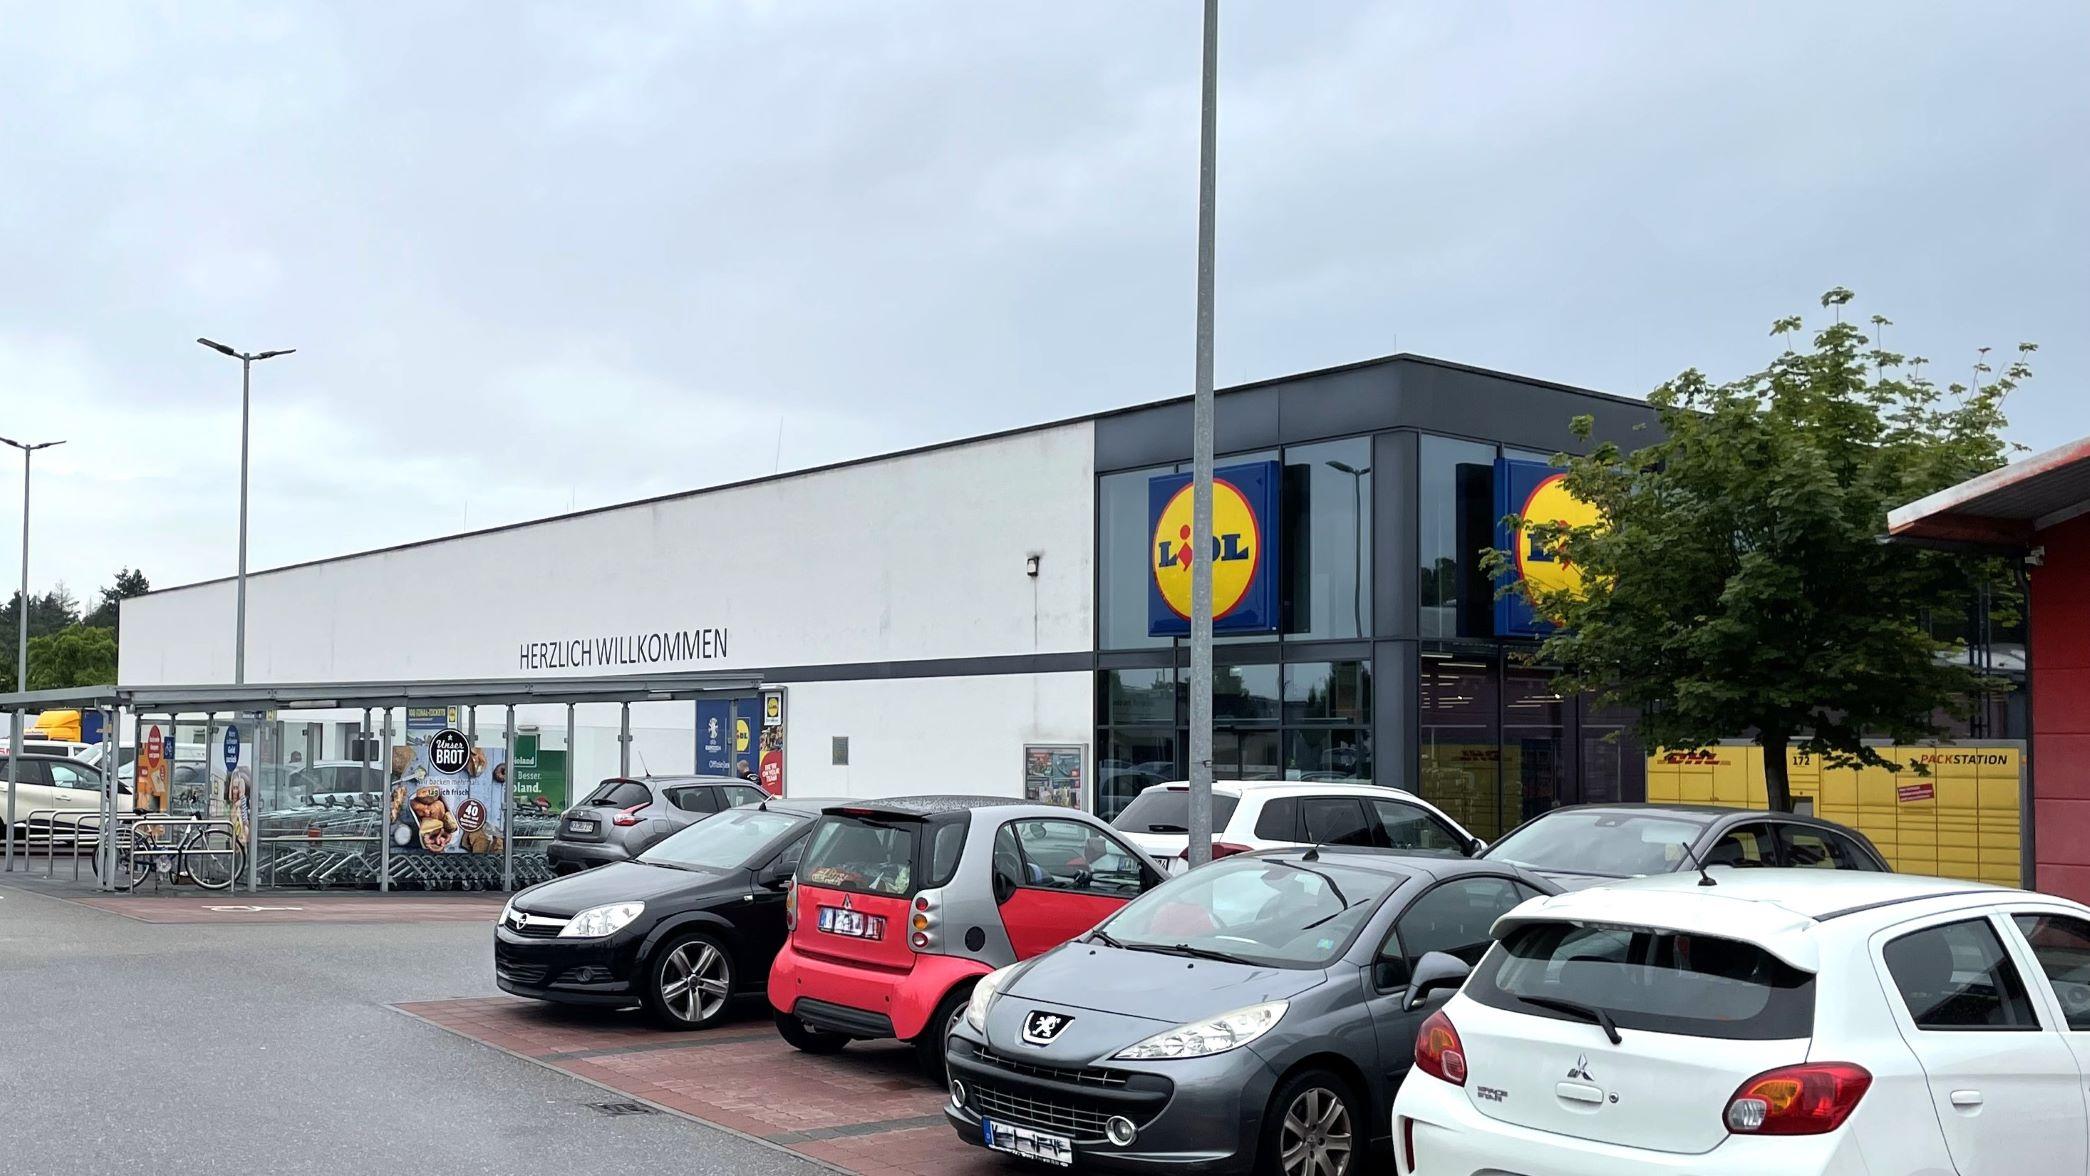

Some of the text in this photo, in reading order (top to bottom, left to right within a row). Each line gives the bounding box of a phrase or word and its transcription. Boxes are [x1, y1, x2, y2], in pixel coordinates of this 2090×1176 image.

[520, 628, 728, 670] HERZLICH WILLKOMMEN
[436, 740, 464, 749] Unser
[436, 749, 465, 765] BROT
[1792, 756, 1810, 766] 172
[1921, 754, 2008, 765] PACKSTATION
[517, 770, 542, 780] Besser.
[451, 788, 469, 796] frisch
[465, 805, 478, 817] 40
